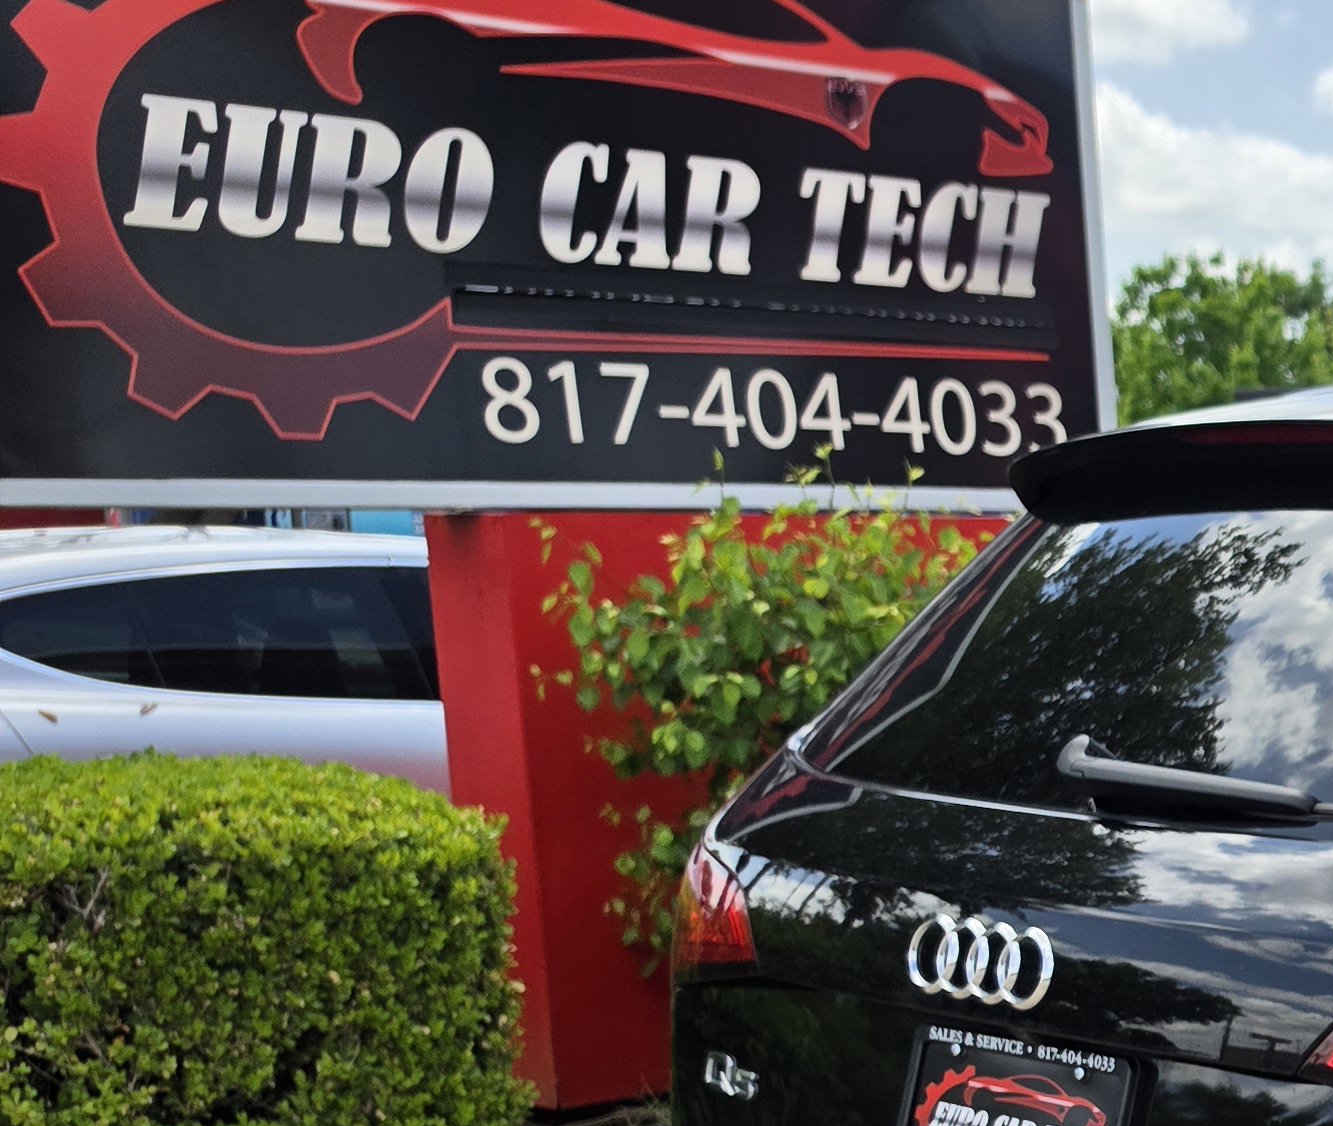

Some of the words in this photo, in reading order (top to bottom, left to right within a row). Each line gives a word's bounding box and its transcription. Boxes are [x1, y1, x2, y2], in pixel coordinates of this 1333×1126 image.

[123, 93, 495, 254] EURO
[539, 141, 761, 276] CAR
[800, 167, 1051, 298] TECH
[482, 356, 1068, 456] 817-404-4033
[704, 1051, 759, 1100] Q5
[928, 1026, 963, 1044] SALES
[964, 1032, 975, 1046] &
[976, 1034, 1024, 1055] SERVICE
[1037, 1045, 1116, 1072] 817-404-4033
